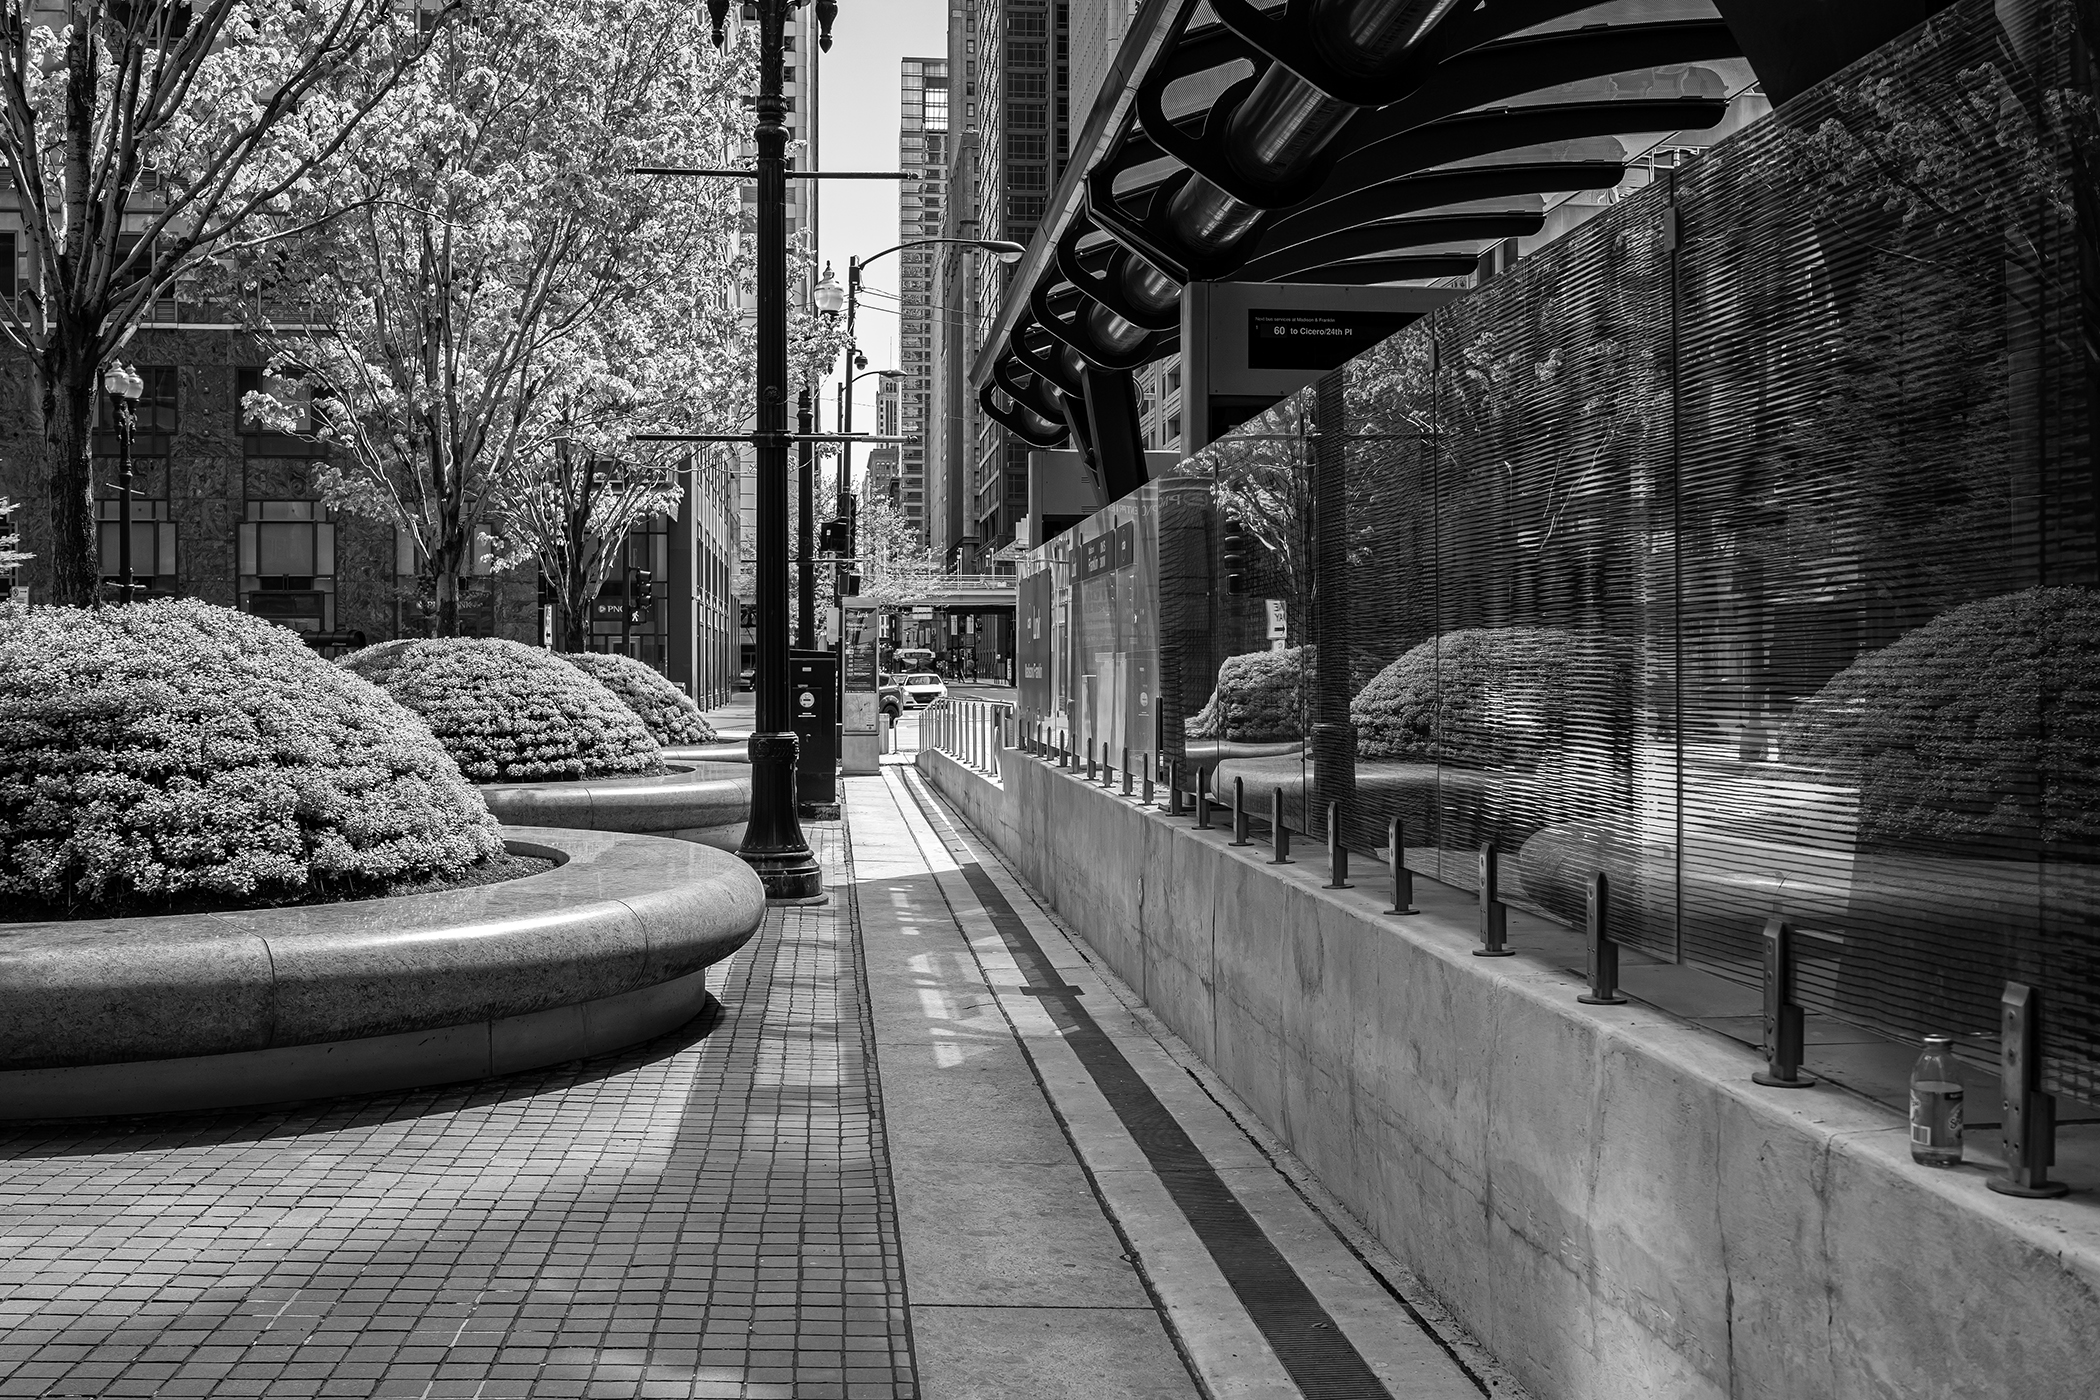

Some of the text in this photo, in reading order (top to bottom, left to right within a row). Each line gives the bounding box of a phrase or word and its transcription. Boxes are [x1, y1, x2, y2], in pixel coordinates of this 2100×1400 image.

[1273, 325, 1286, 336] 60
[1290, 327, 1299, 335] to
[1299, 327, 1343, 336] Cicero/24th
